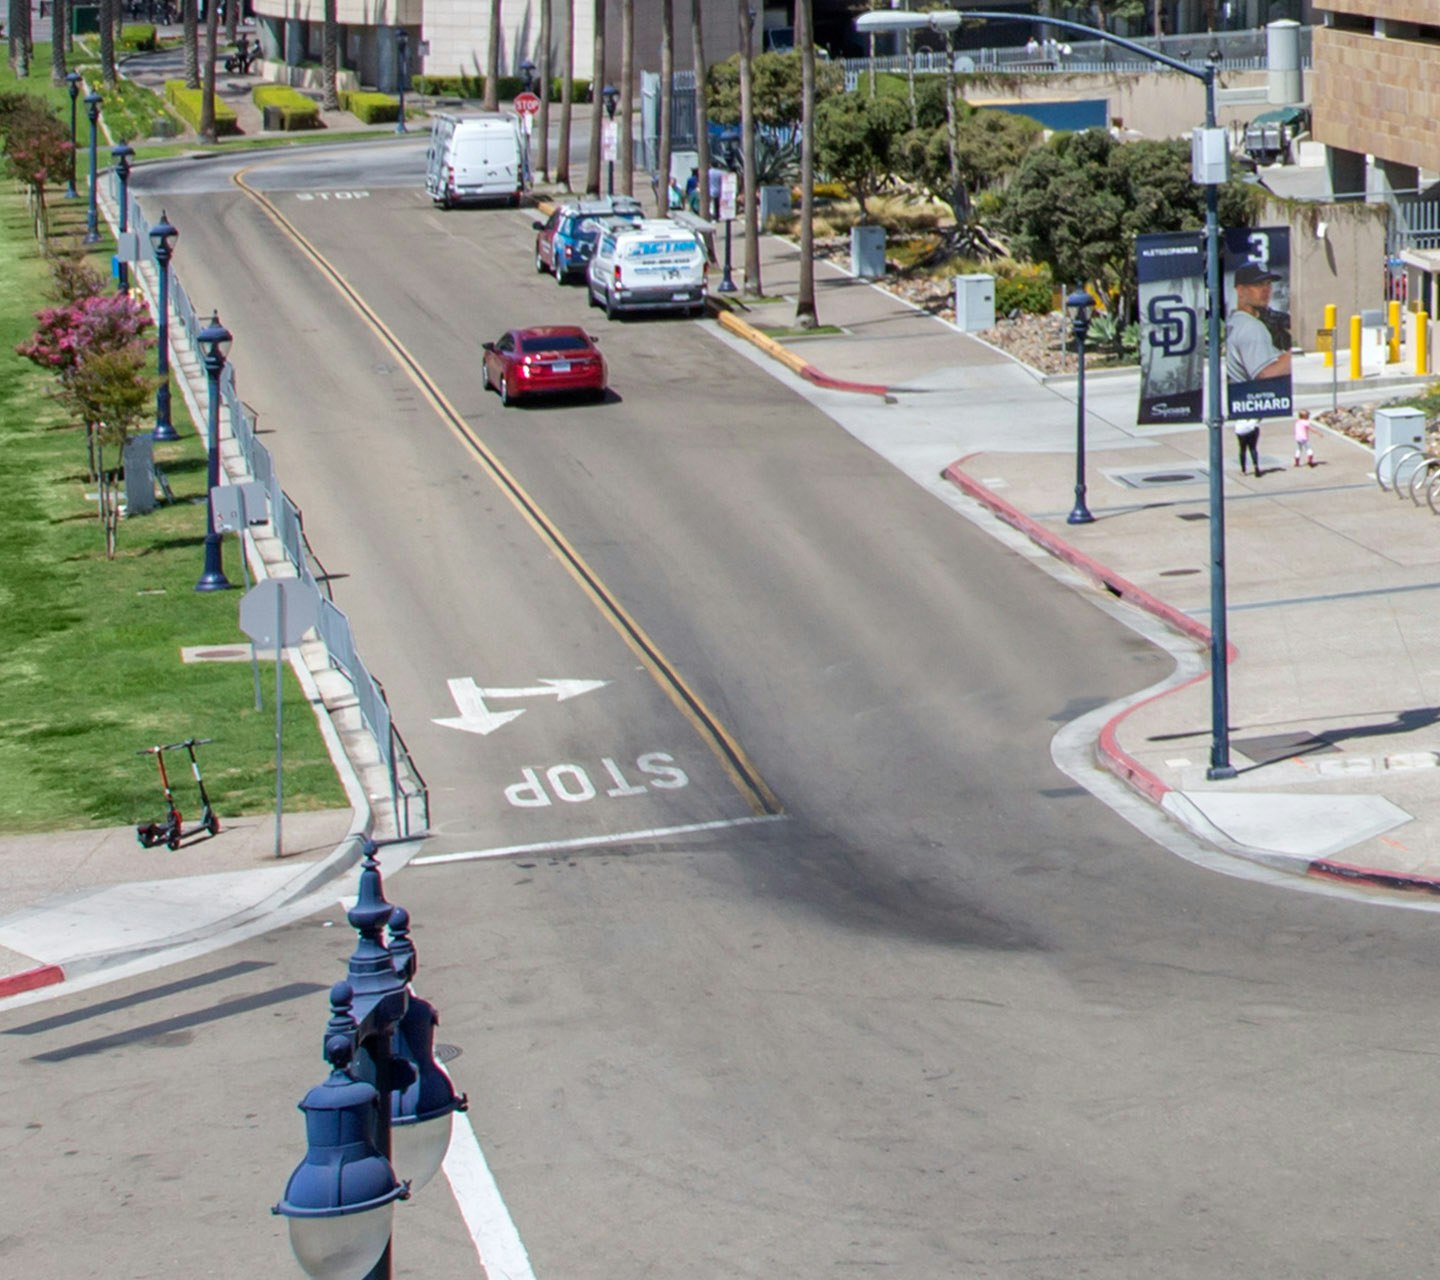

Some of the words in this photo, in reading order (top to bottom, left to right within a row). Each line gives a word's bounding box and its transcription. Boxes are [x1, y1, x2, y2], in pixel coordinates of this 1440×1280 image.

[514, 99, 539, 111] STOP
[296, 191, 370, 201] STOP
[1247, 232, 1270, 264] 3
[1232, 397, 1290, 413] RICHARD
[503, 751, 689, 807] STOP
